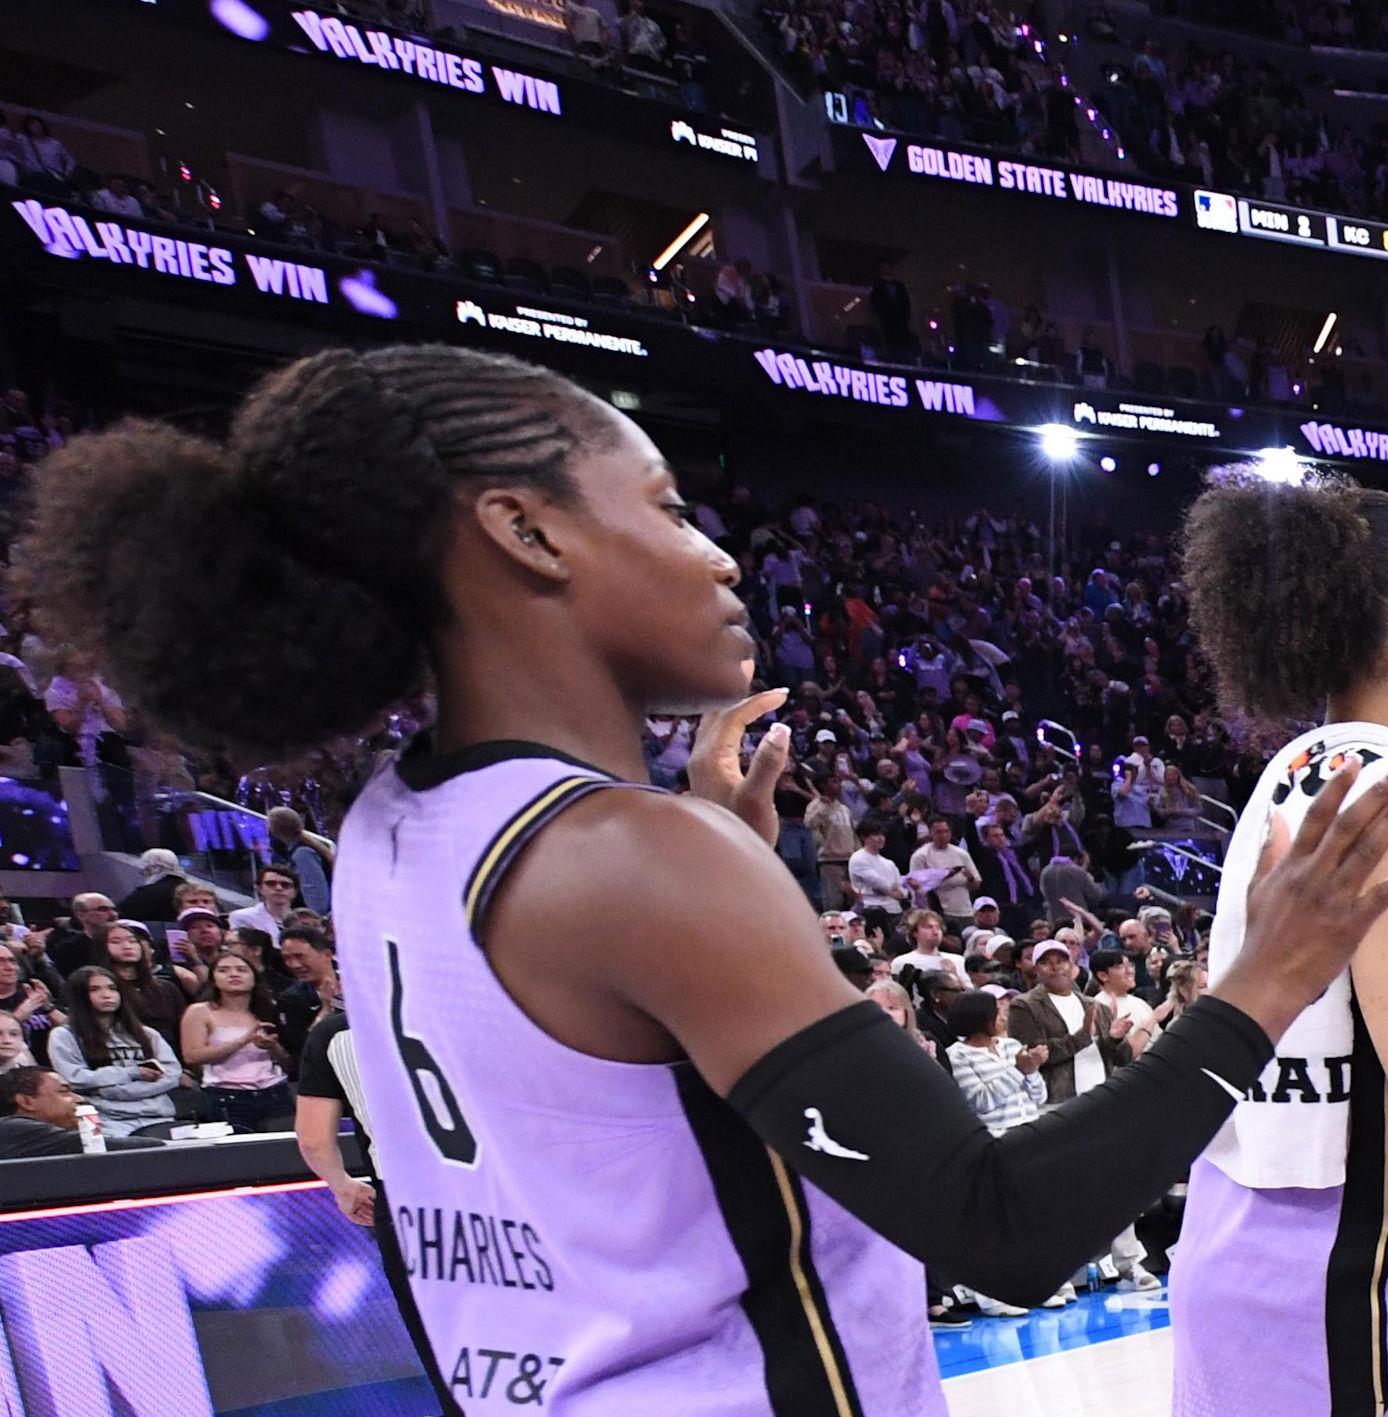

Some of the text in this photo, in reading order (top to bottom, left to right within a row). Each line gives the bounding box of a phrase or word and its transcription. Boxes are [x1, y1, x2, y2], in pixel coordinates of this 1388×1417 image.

[291, 10, 485, 93] VALKYRIES
[491, 66, 561, 115] WIN
[907, 144, 1178, 218] GOLDEN STATE VALKYRIES
[1251, 208, 1289, 231] MIN
[11, 199, 328, 304] VALKYRIES WIN
[1343, 226, 1369, 245] KC
[754, 348, 974, 415] VALKYRIES WIN
[384, 937, 481, 1169] 6
[399, 1206, 554, 1291] CHARLES
